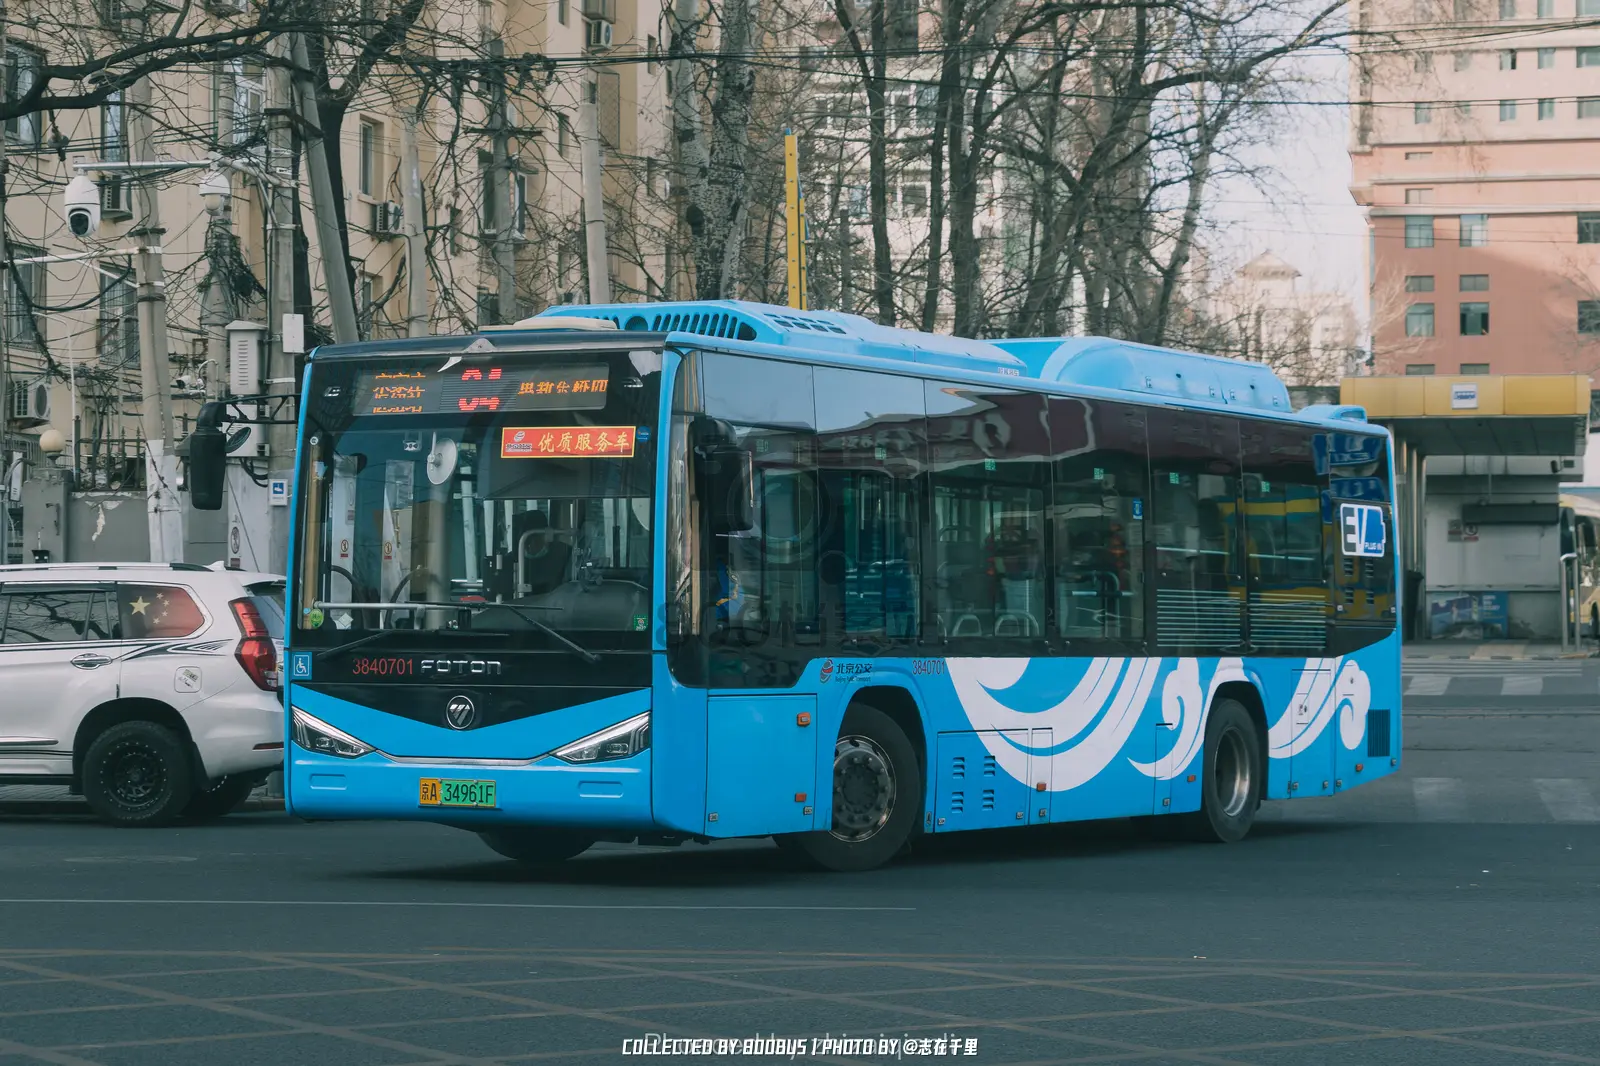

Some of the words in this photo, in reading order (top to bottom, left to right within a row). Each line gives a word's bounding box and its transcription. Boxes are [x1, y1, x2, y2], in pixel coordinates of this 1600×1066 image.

[538, 431, 629, 453] 优质服务车
[352, 658, 413, 675] 3840701
[421, 659, 501, 675] FOTON
[836, 663, 873, 674] 北京公交
[912, 659, 946, 675] 3840701
[421, 783, 438, 801] 京A
[444, 783, 494, 803] 34961F
